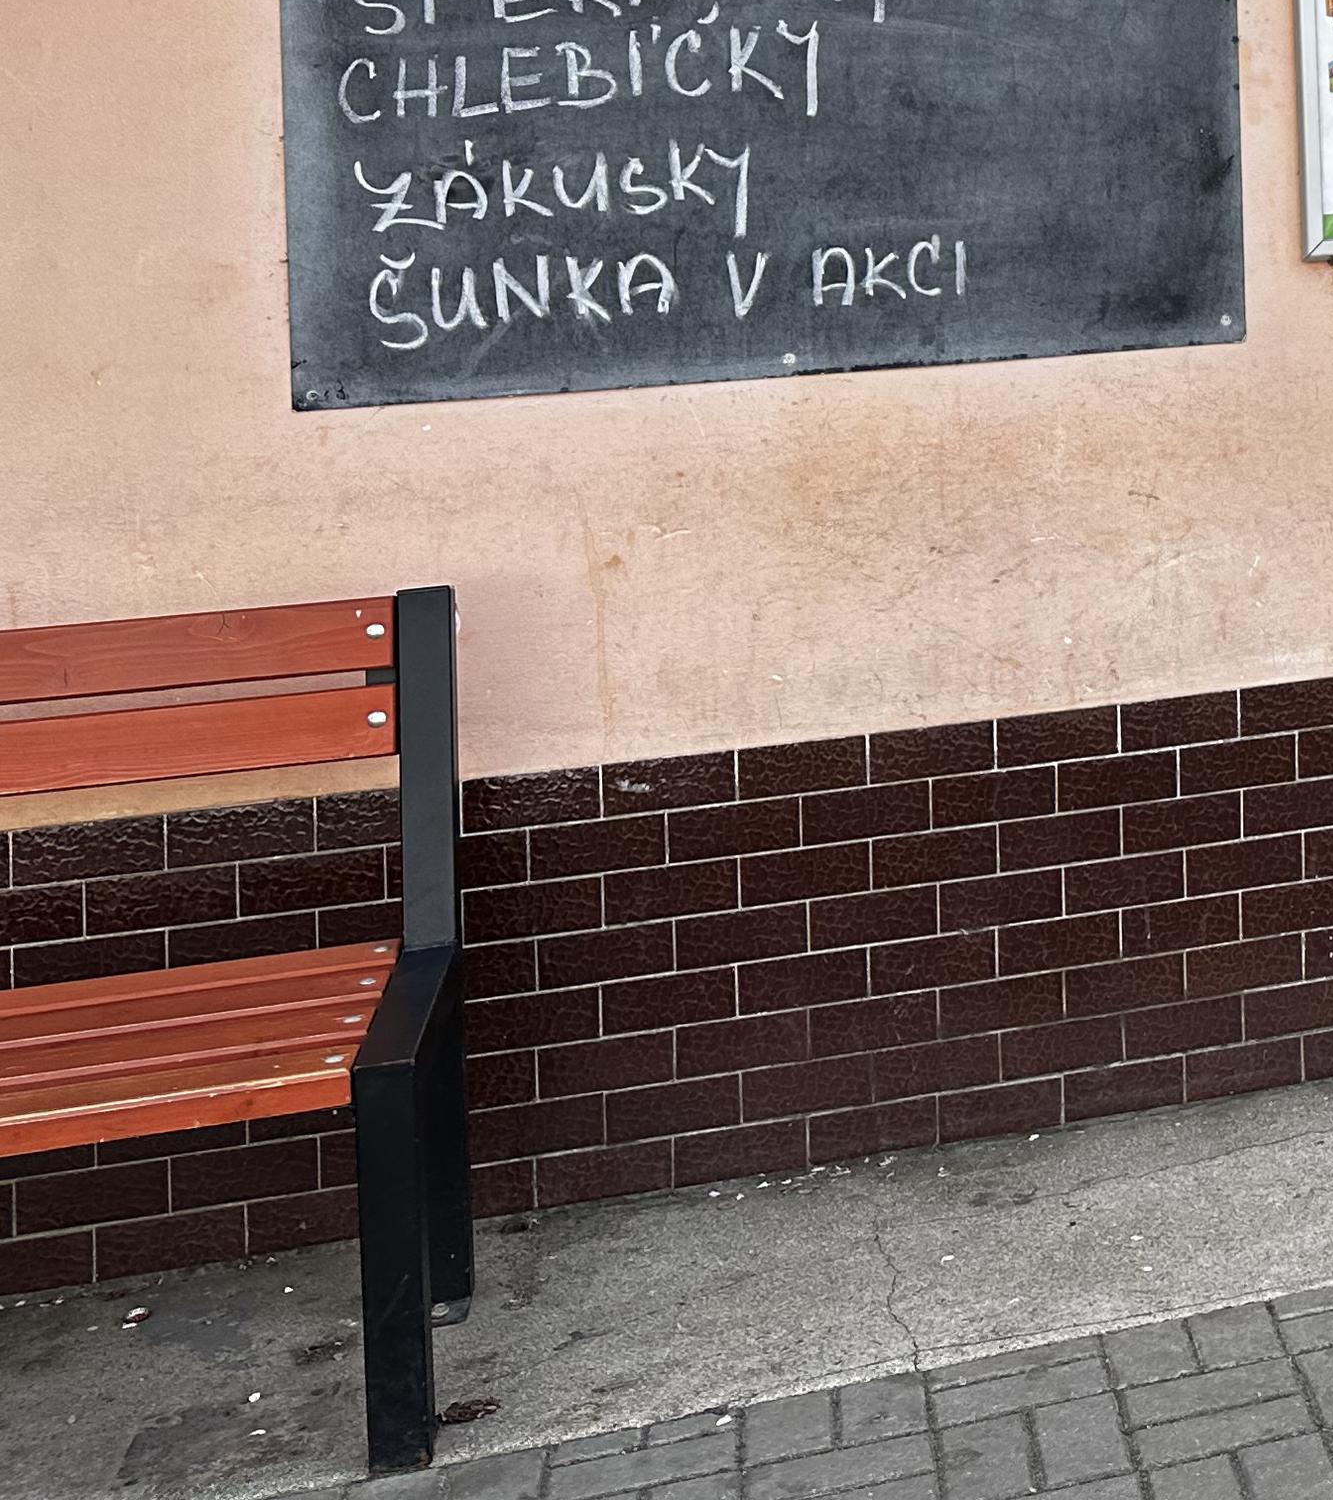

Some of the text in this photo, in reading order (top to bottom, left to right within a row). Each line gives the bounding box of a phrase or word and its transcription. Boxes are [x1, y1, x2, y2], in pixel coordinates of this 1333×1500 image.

[338, 8, 821, 123] CHLEBÍČKY
[369, 235, 967, 350] ŠUNKA V AKCI
